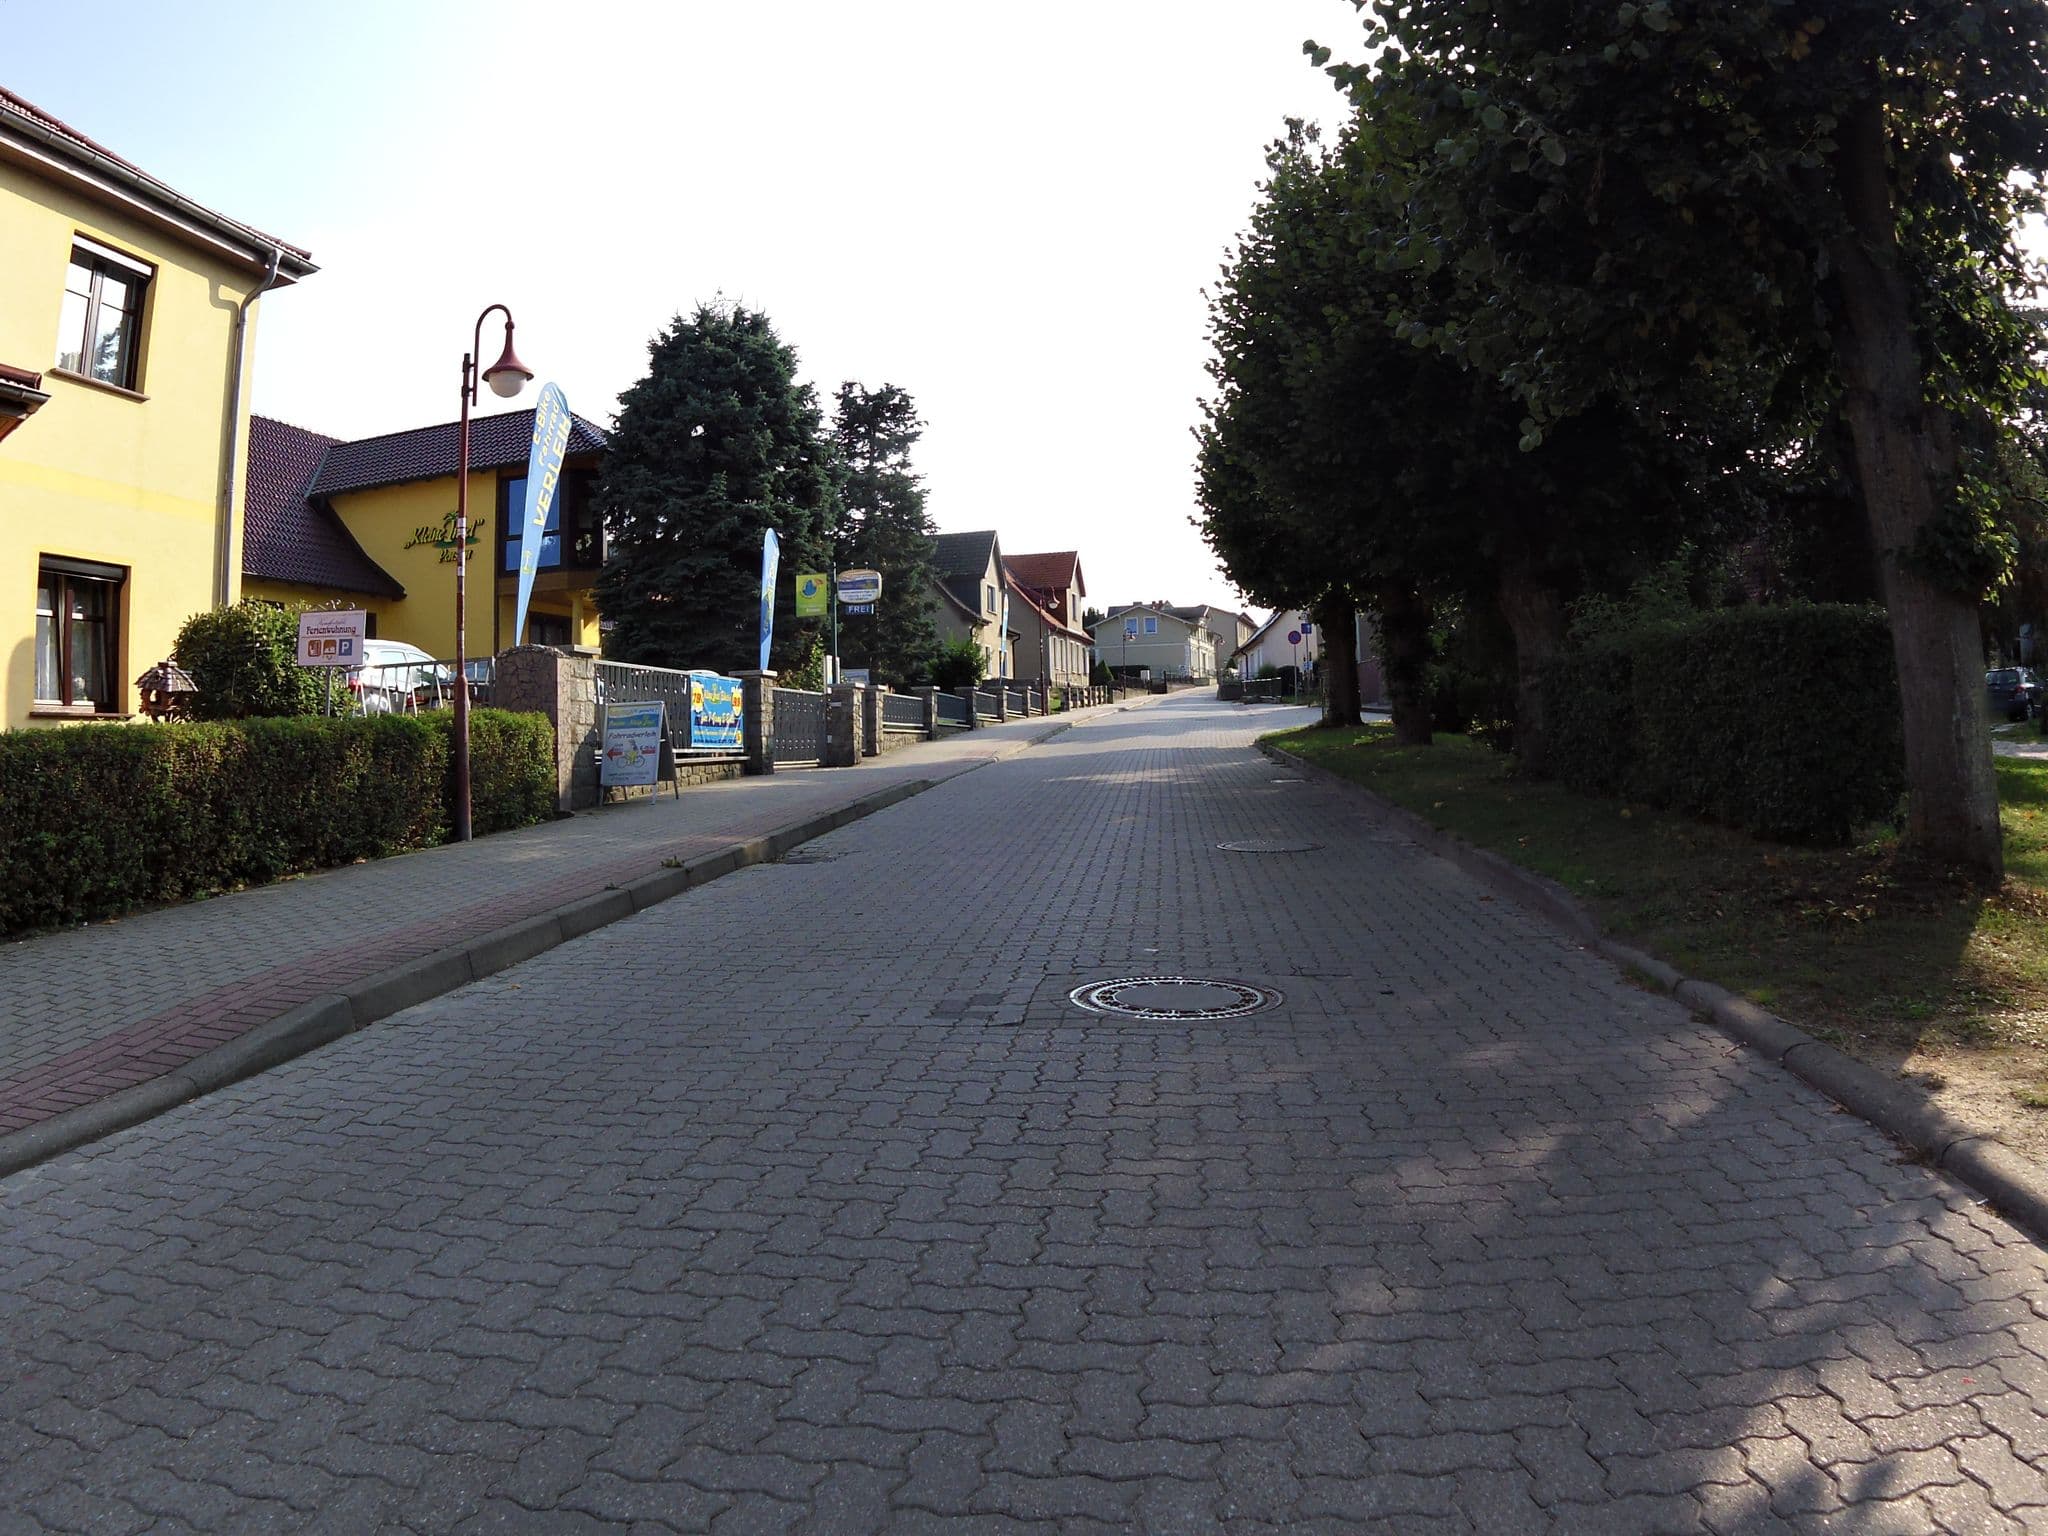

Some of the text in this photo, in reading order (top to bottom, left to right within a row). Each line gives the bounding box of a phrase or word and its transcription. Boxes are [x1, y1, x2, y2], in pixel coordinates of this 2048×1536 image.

[532, 413, 571, 526] VERLEIH
[848, 604, 869, 613] FREI
[306, 625, 356, 635] Ferienwohnung
[341, 641, 350, 654] P
